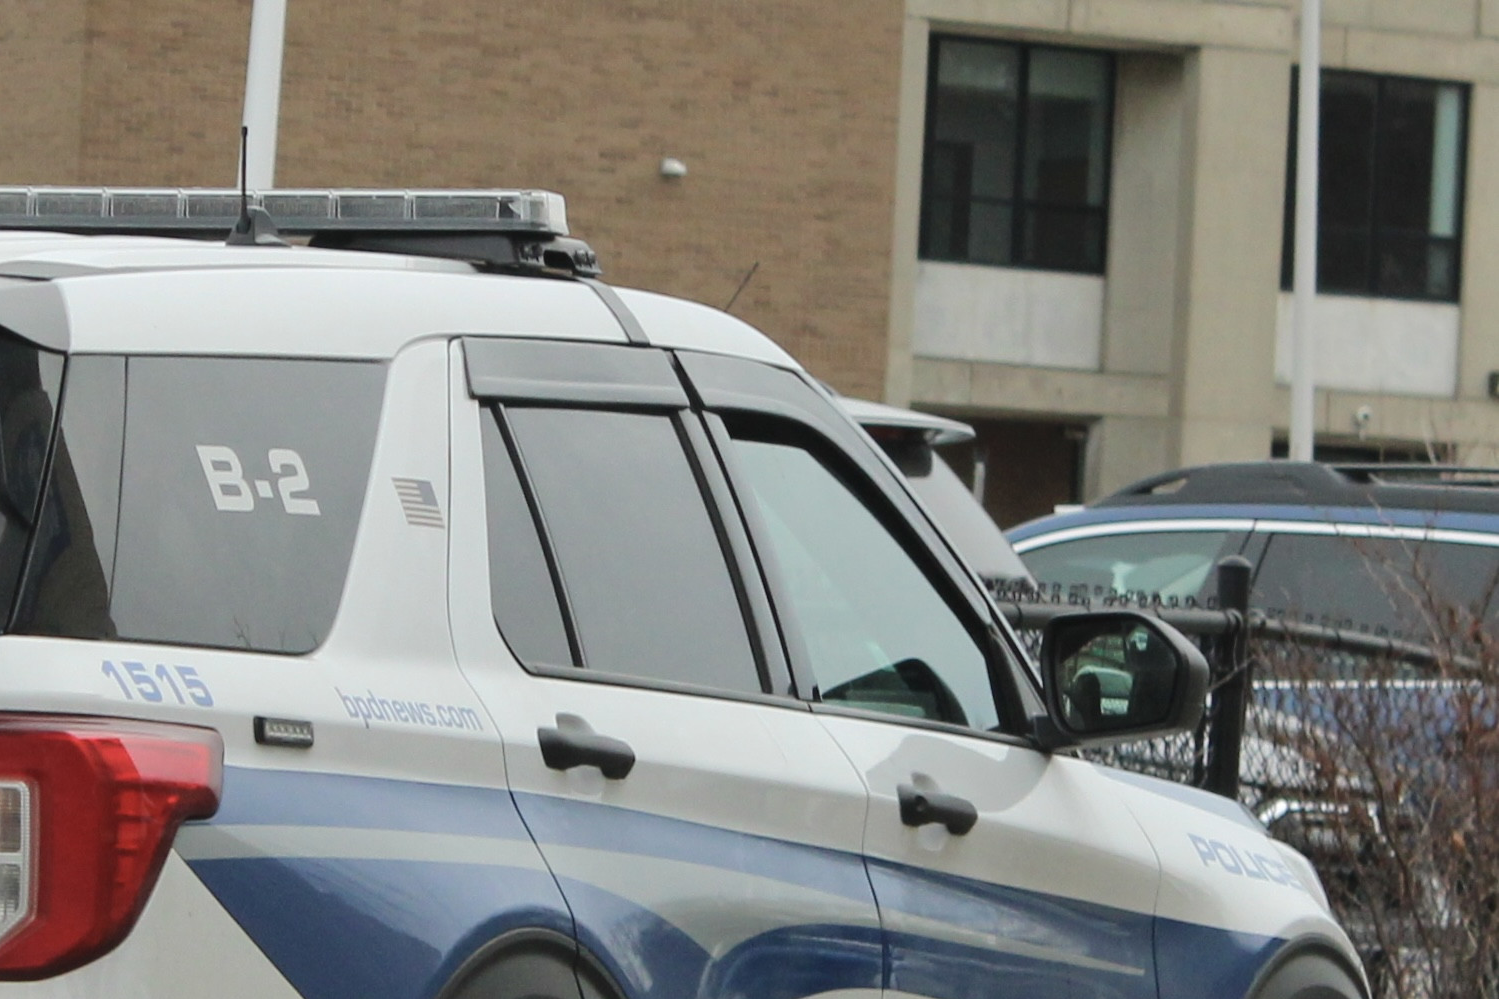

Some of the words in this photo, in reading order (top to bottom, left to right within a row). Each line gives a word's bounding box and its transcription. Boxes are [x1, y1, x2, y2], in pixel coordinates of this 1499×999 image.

[196, 444, 321, 517] B-2
[101, 659, 214, 708] 1515
[336, 687, 483, 732] bpdnews.com
